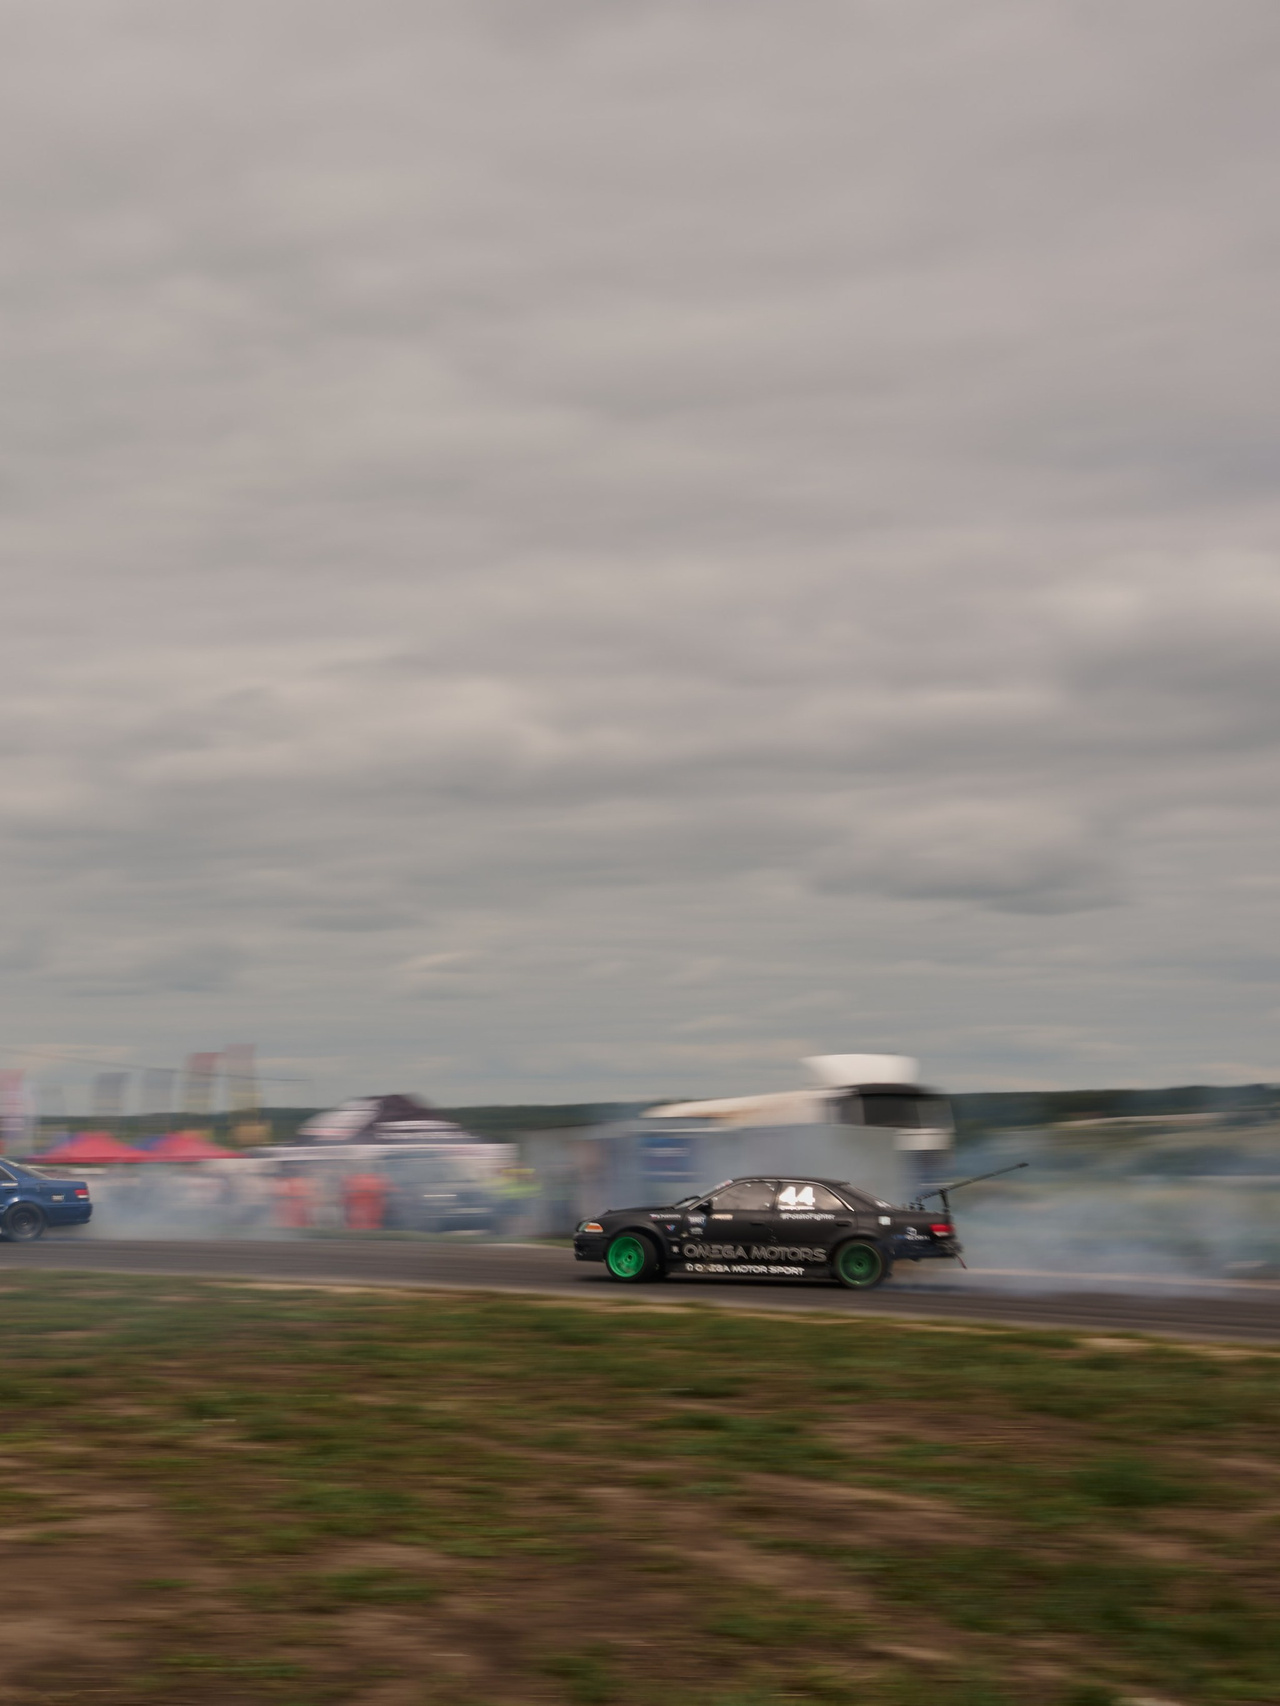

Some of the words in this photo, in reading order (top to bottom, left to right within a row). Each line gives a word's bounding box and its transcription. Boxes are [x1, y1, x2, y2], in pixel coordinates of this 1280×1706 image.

[778, 1186, 816, 1205] 44
[750, 1244, 828, 1262] MOTORS
[731, 1264, 769, 1274] MOTOR
[768, 1265, 806, 1276] SPORT
